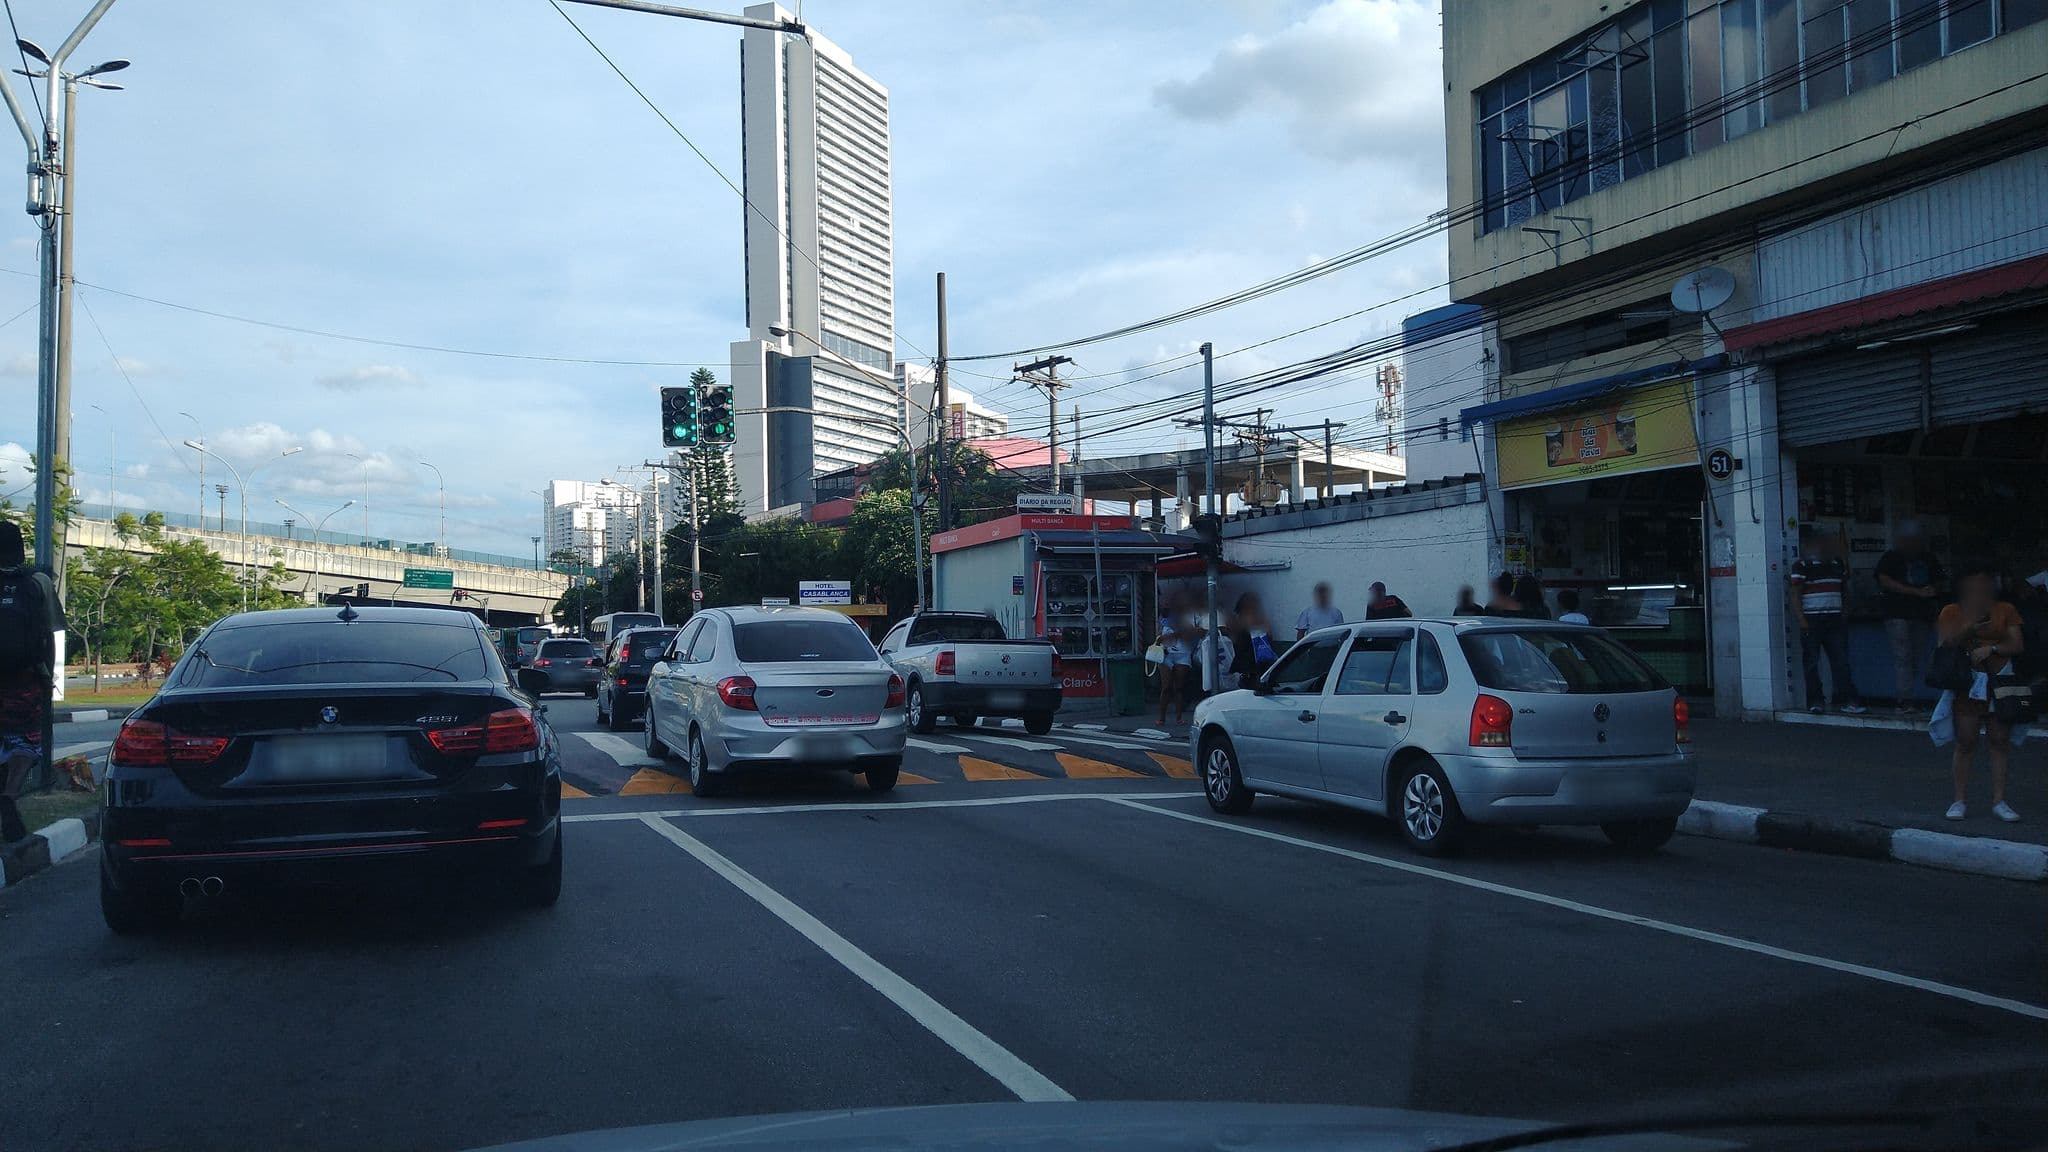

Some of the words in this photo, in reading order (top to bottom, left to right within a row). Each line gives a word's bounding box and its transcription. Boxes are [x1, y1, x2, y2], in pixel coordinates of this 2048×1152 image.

[1585, 438, 1595, 446] da
[1711, 456, 1728, 473] 51
[1019, 497, 1040, 505] DIÁRIO
[1050, 497, 1071, 505] REGIÃO
[970, 670, 1040, 678] ROBUST
[1062, 676, 1093, 688] Claro
